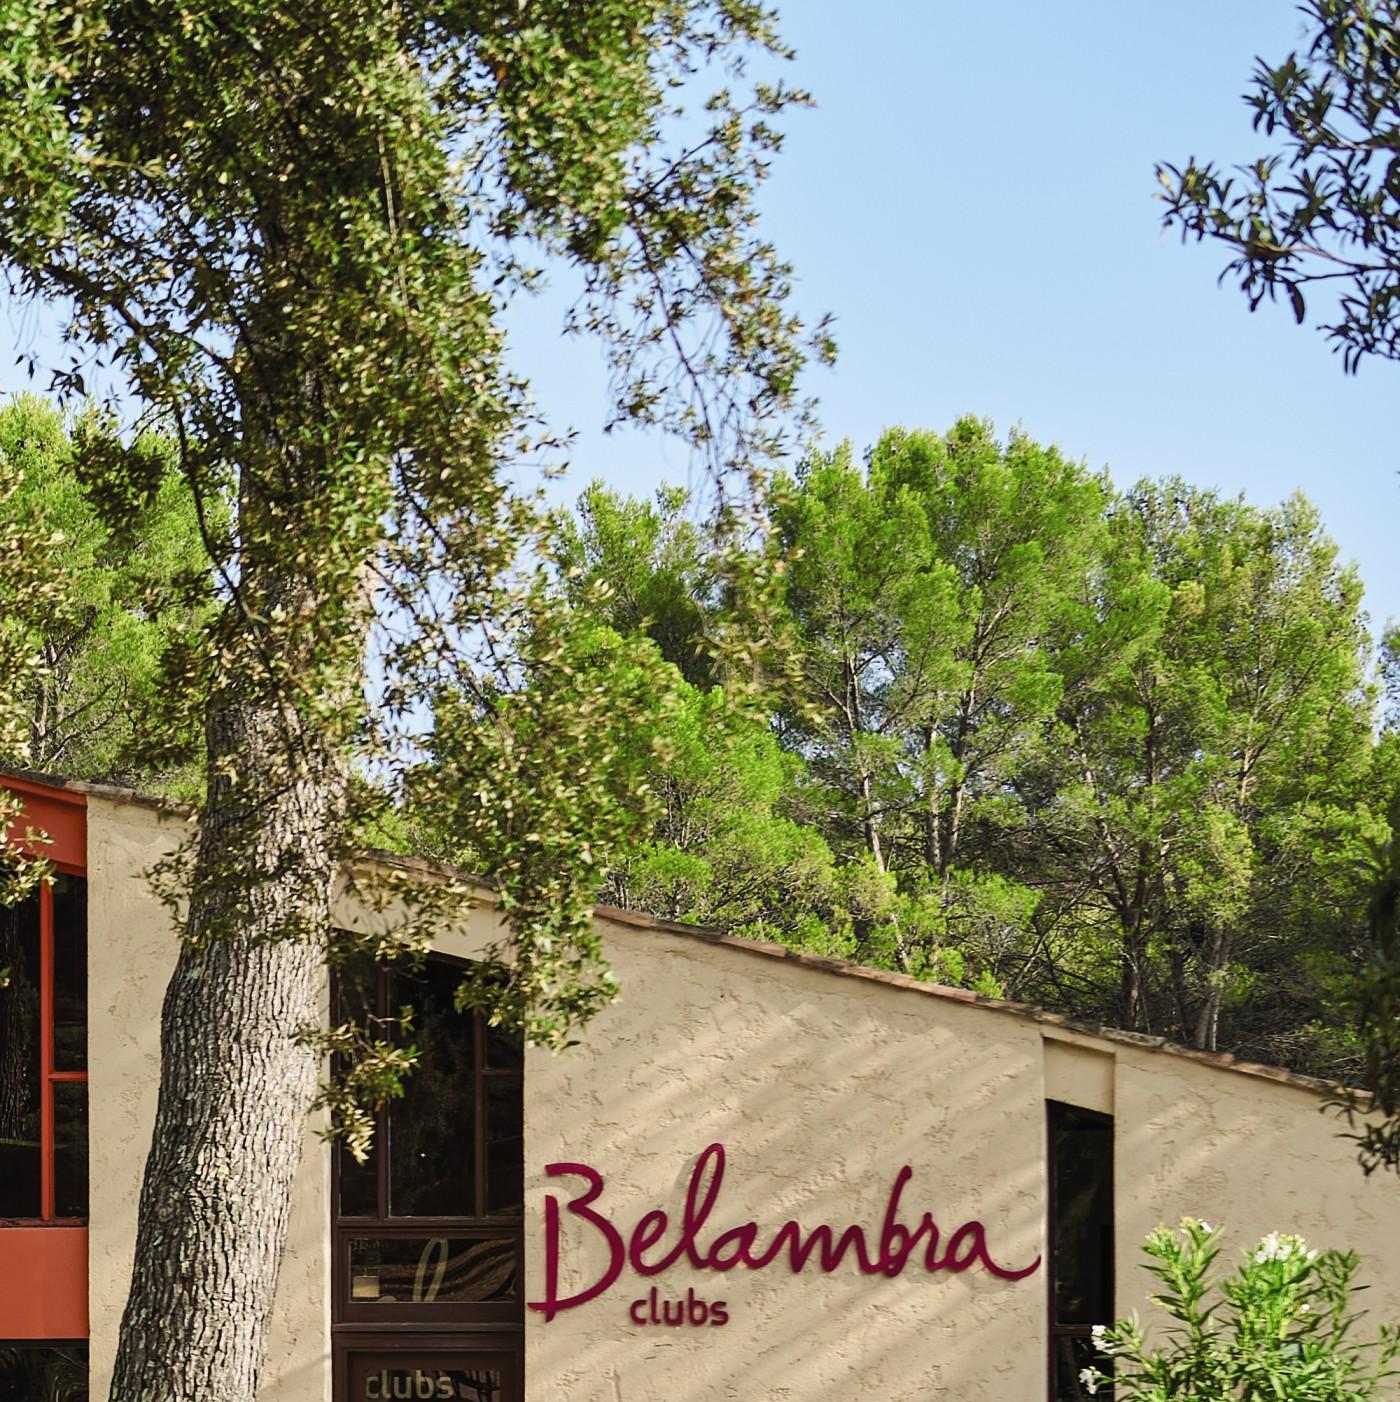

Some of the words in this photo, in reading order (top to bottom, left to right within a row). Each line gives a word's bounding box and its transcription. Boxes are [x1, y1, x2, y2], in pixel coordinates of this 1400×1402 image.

[527, 1142, 1042, 1323] Belambra
[630, 1286, 730, 1327] clubs
[366, 1369, 455, 1399] clubs
